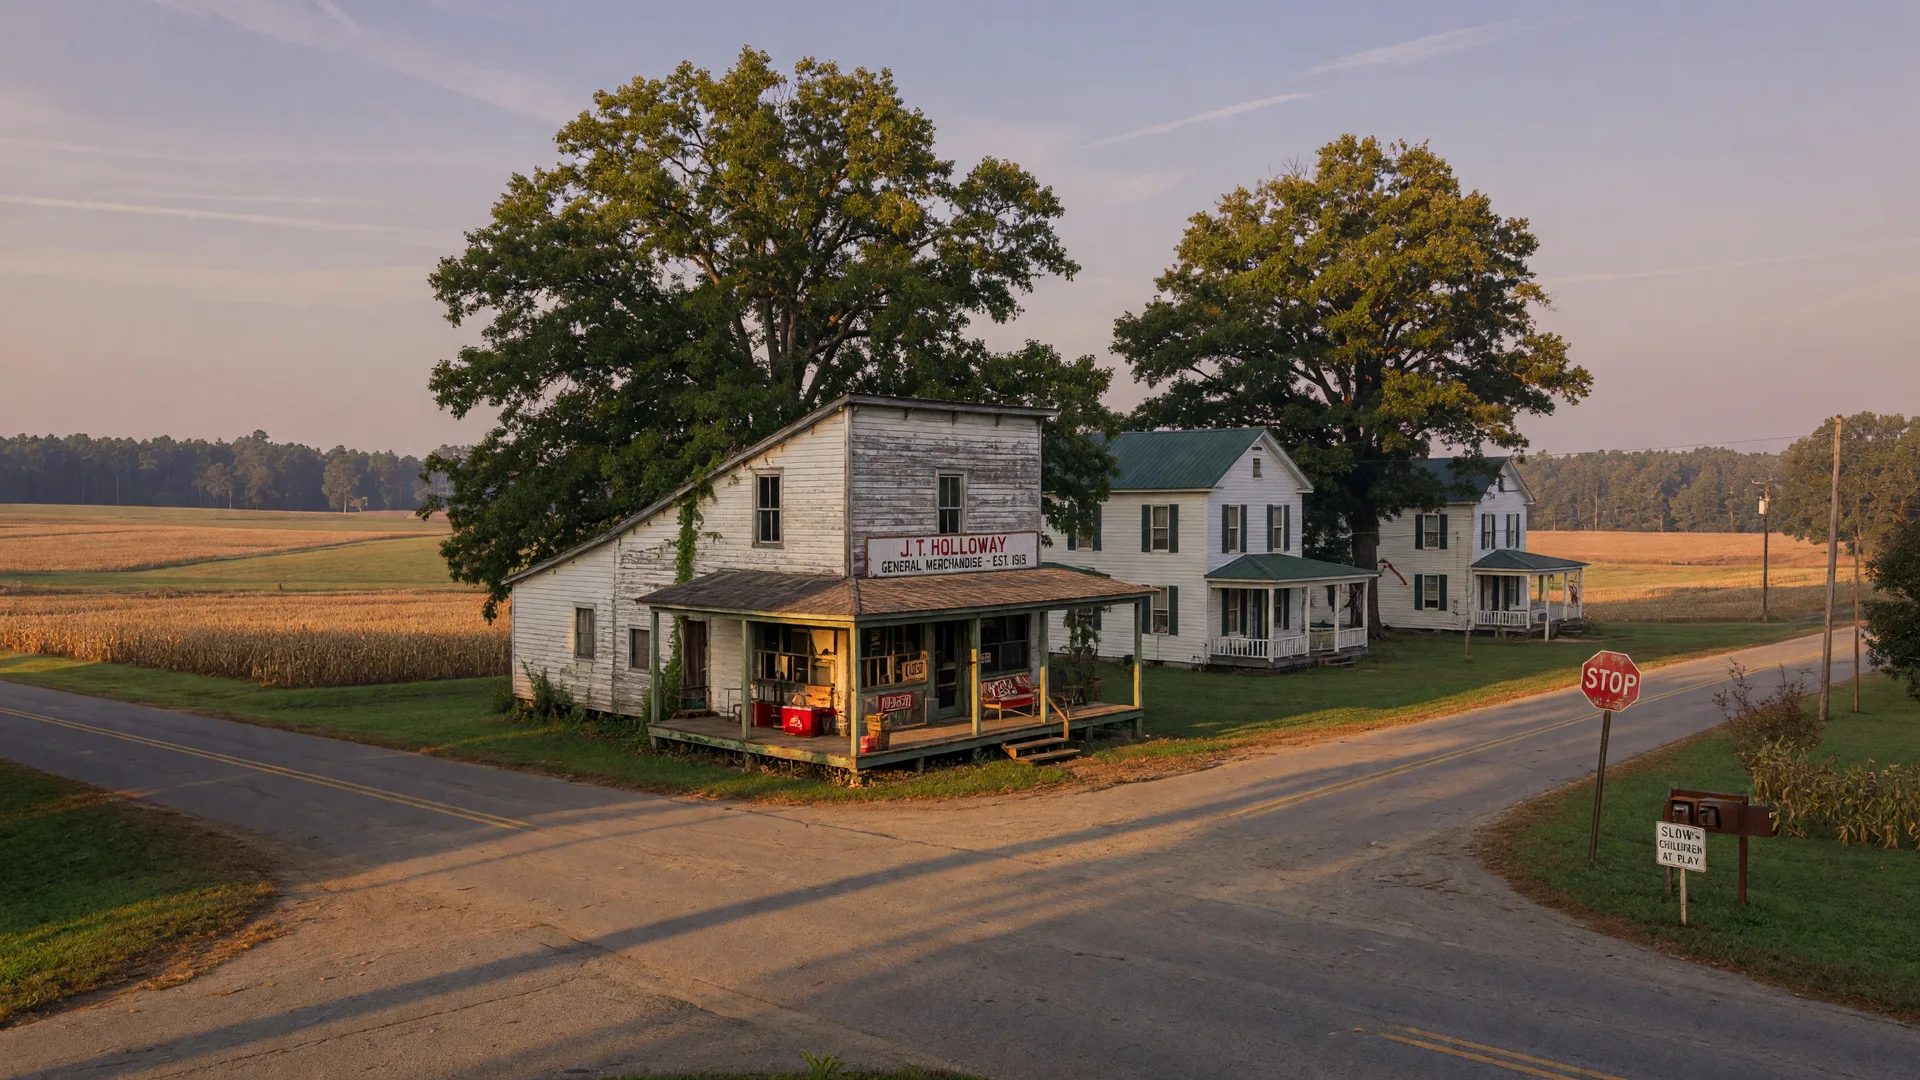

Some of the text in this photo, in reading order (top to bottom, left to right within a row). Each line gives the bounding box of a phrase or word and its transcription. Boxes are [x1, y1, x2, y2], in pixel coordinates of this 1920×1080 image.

[931, 536, 1007, 556] HOLLOWAY
[881, 559, 922, 574] GENERAL
[925, 556, 983, 572] MERCHANDISE
[992, 554, 1009, 567] EST.
[1011, 553, 1027, 566] 1913
[1585, 667, 1637, 696] STOP
[1662, 852, 1699, 866] AT PLAY
